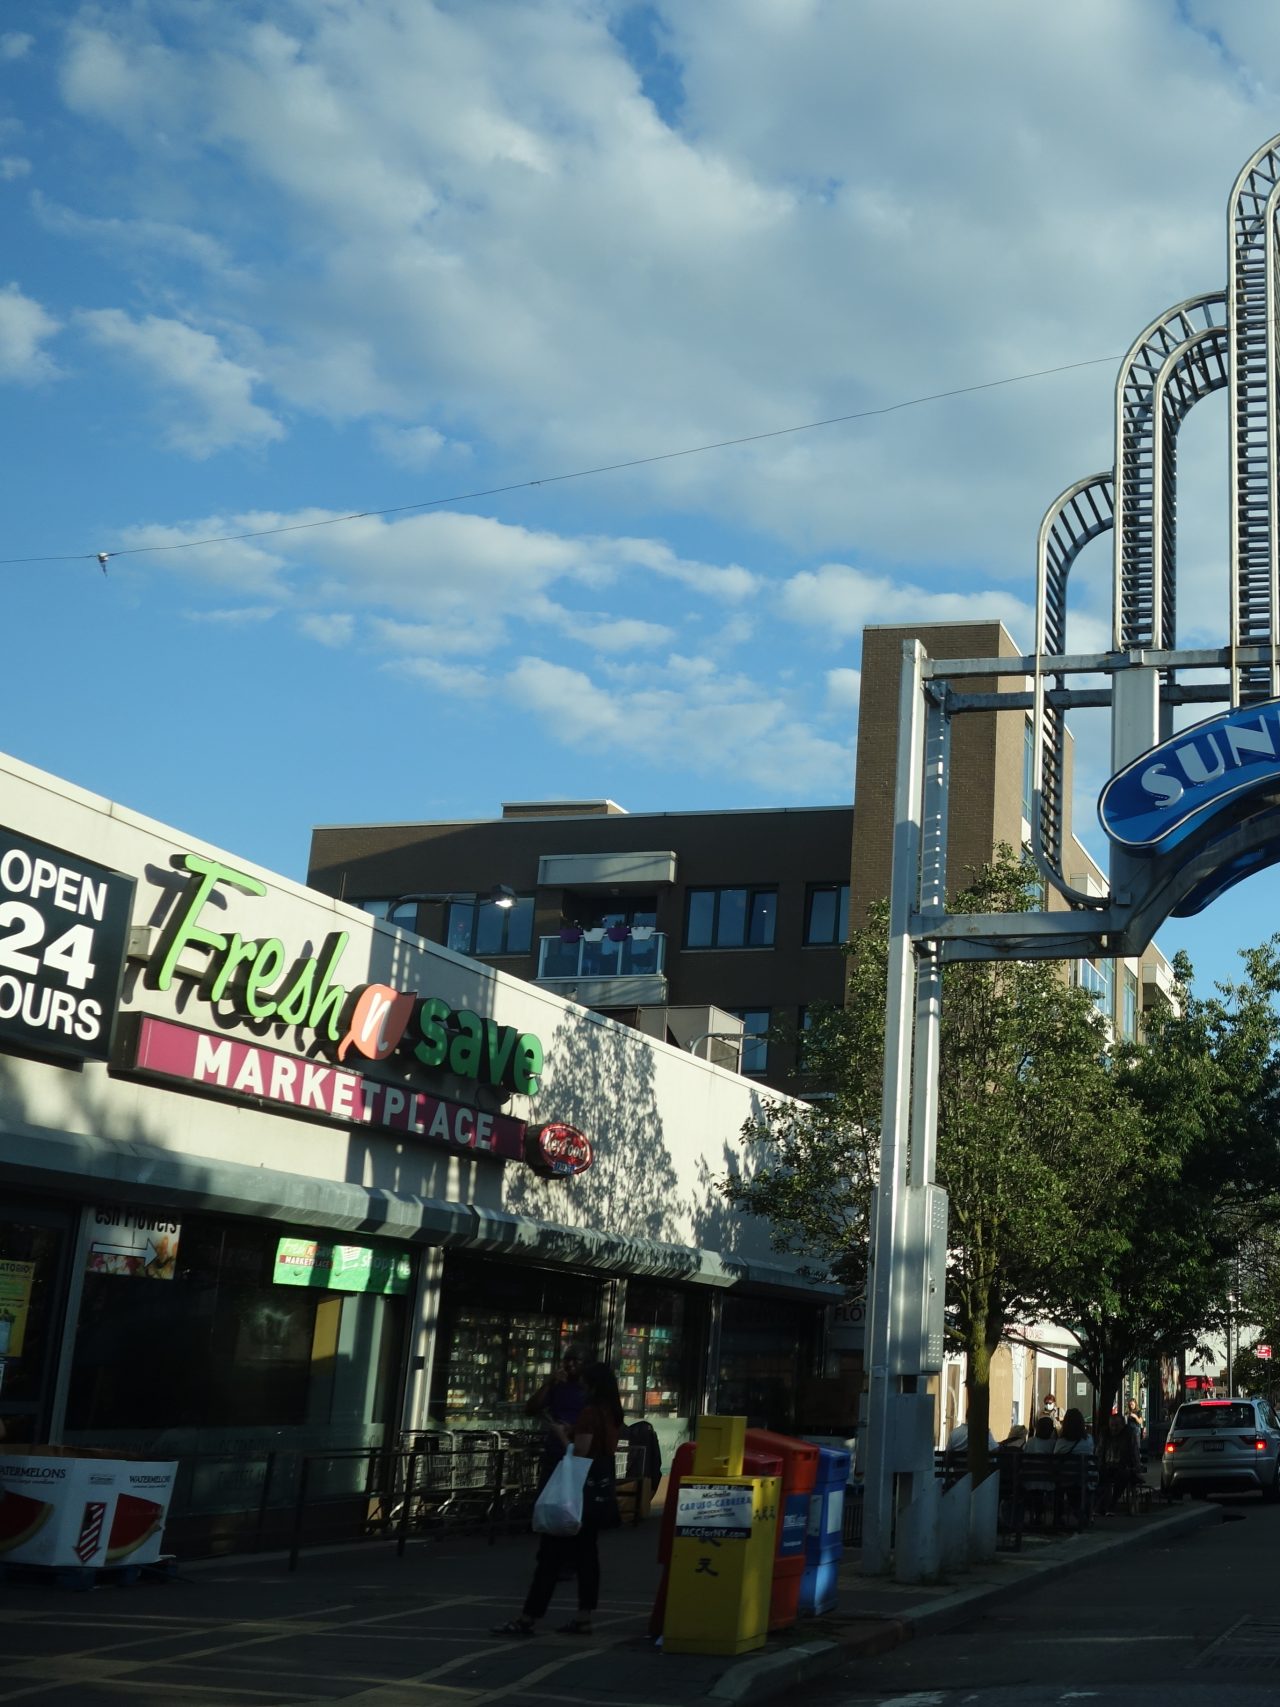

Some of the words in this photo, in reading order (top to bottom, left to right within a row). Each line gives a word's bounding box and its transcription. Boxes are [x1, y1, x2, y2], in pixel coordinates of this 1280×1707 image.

[0, 849, 108, 921] OPEN
[0, 901, 96, 990] 24
[157, 853, 350, 1042] Fresh
[413, 997, 544, 1096] save
[0, 975, 102, 1041] OURS
[192, 1034, 497, 1151] MARKETPLACE
[0, 1466, 66, 1479] ATERMELONS
